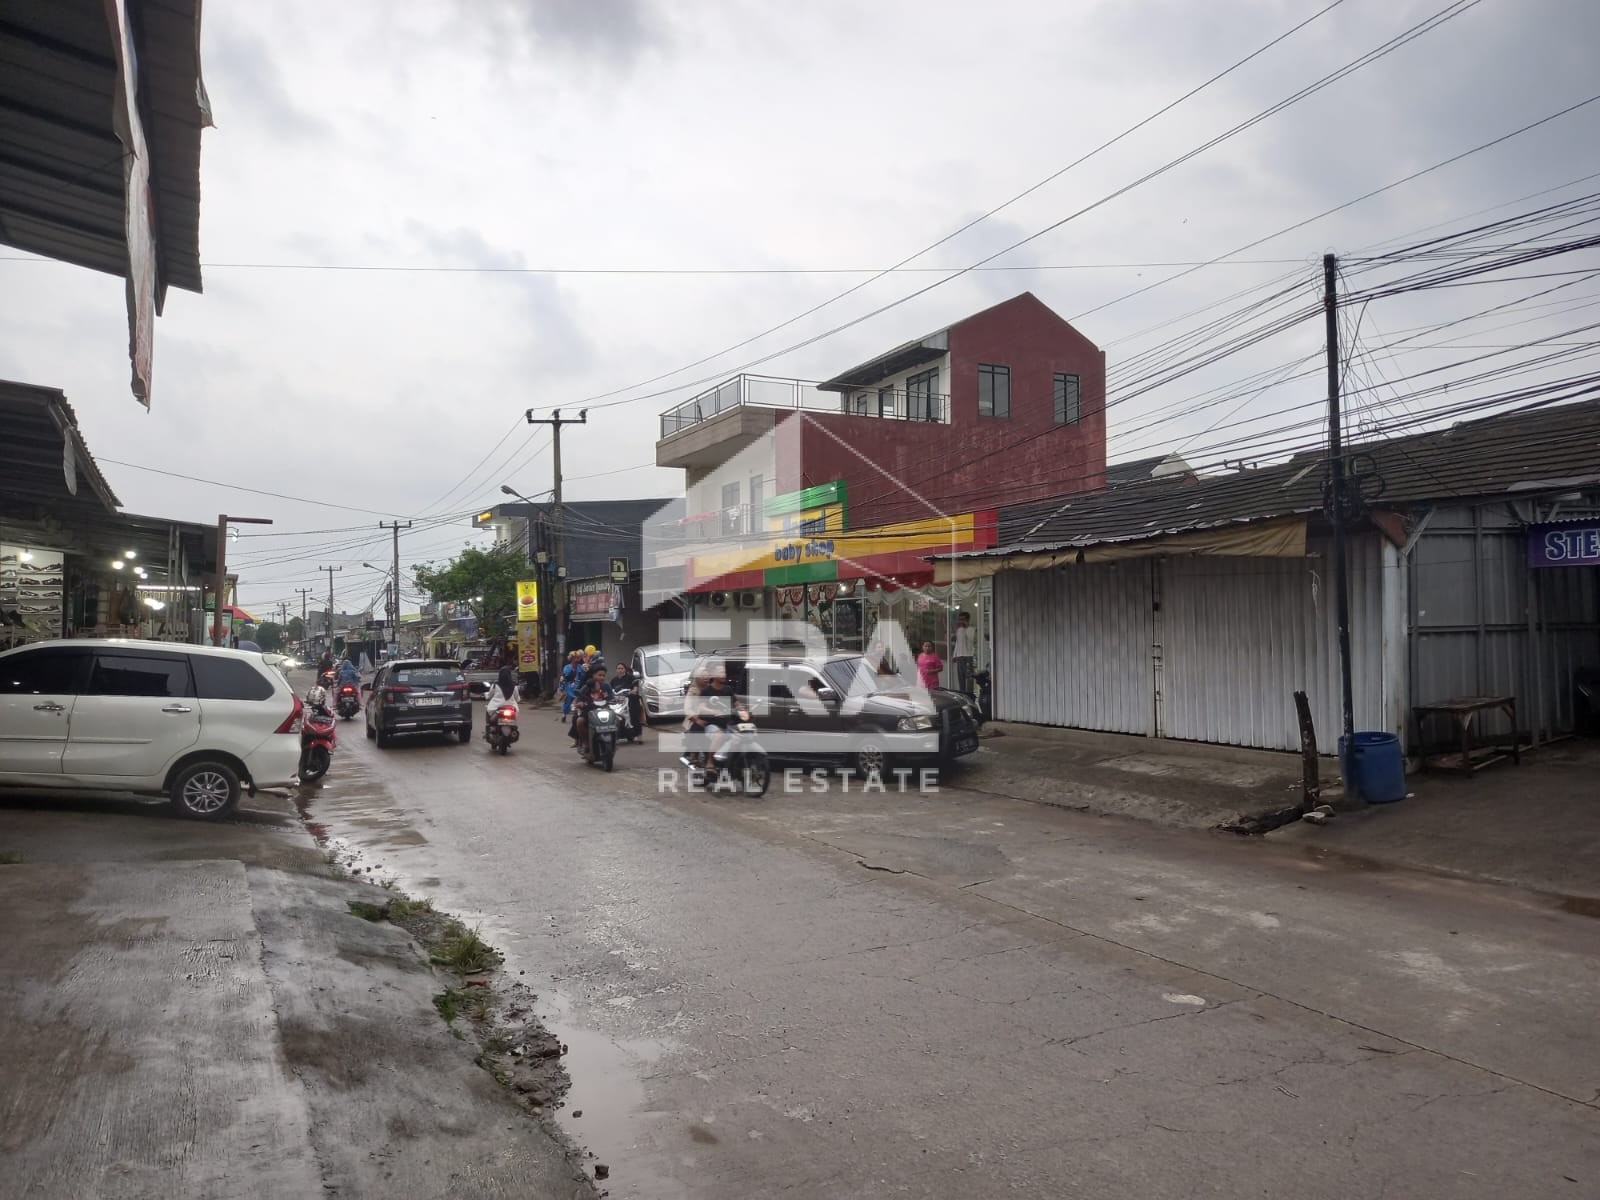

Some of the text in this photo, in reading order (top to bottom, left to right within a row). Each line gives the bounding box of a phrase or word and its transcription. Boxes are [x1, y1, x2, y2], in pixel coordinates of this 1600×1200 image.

[774, 539, 835, 563] baby shop
[1545, 529, 1600, 560] STE
